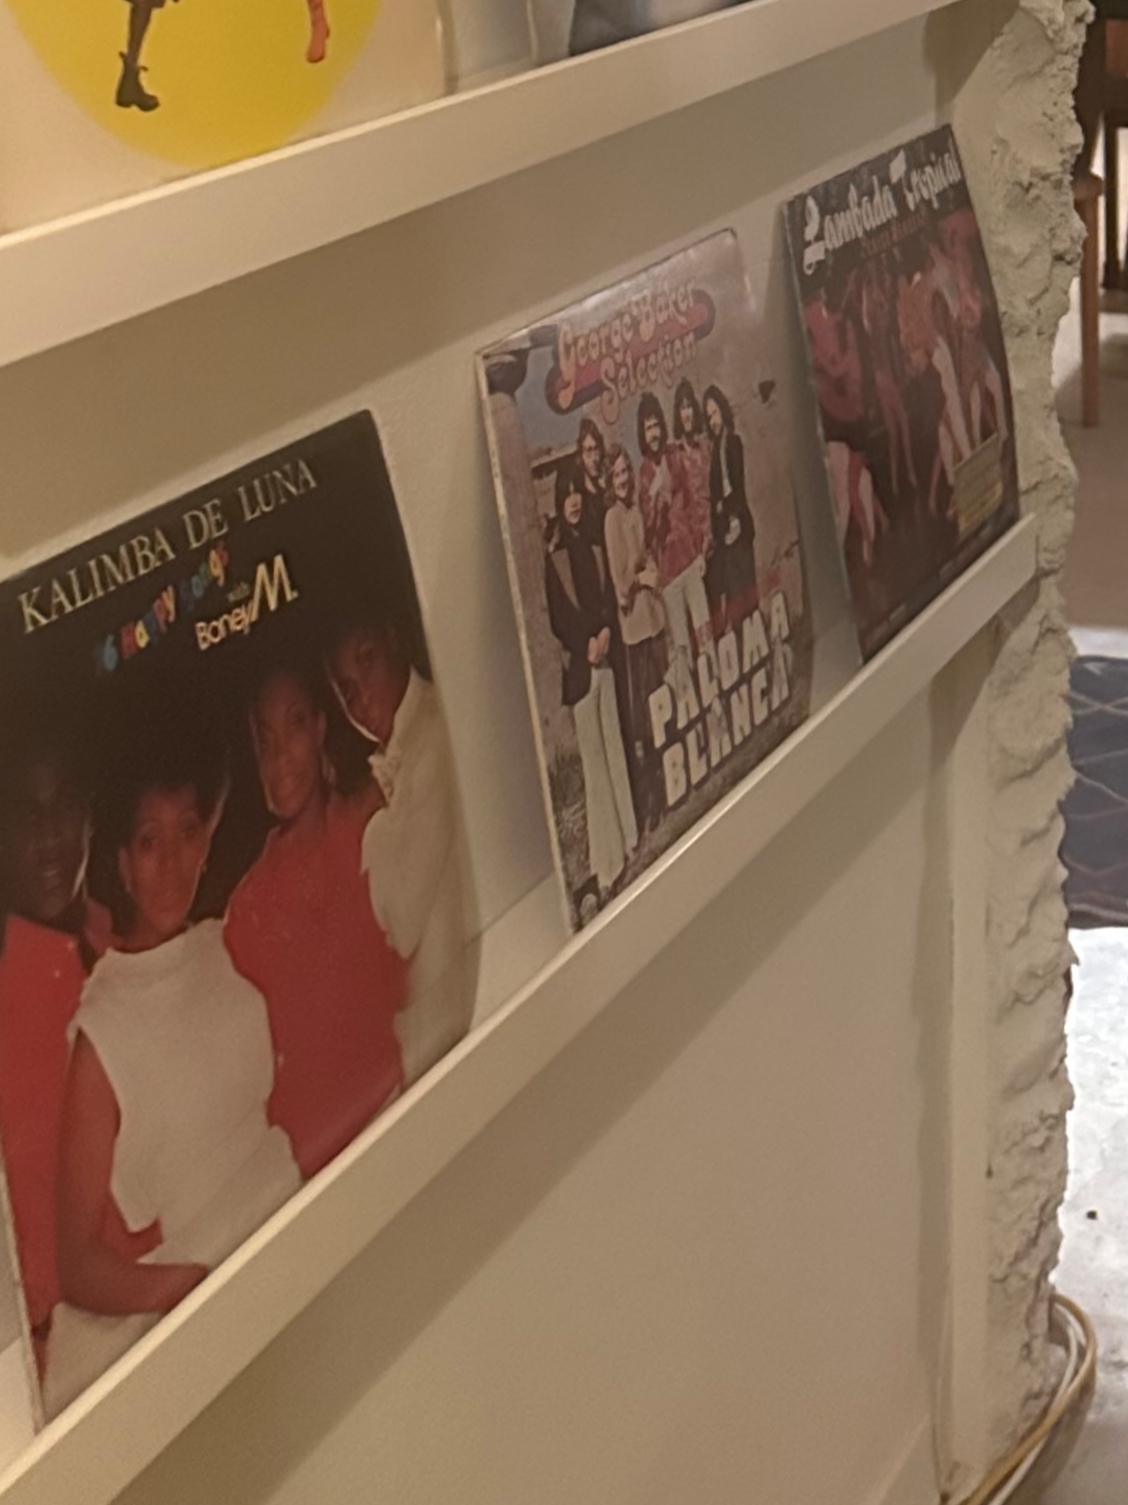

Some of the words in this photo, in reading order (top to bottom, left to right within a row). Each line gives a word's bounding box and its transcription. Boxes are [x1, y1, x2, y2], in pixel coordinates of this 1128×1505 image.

[558, 311, 633, 410] George
[628, 278, 696, 343] Baker
[601, 330, 697, 426] Selection
[17, 526, 176, 634] KALIMBA
[182, 498, 229, 549] DE
[237, 458, 317, 522] LUNA
[195, 601, 253, 651] Boney
[648, 591, 789, 749] PALOMA
[662, 643, 790, 808] BLANCA
